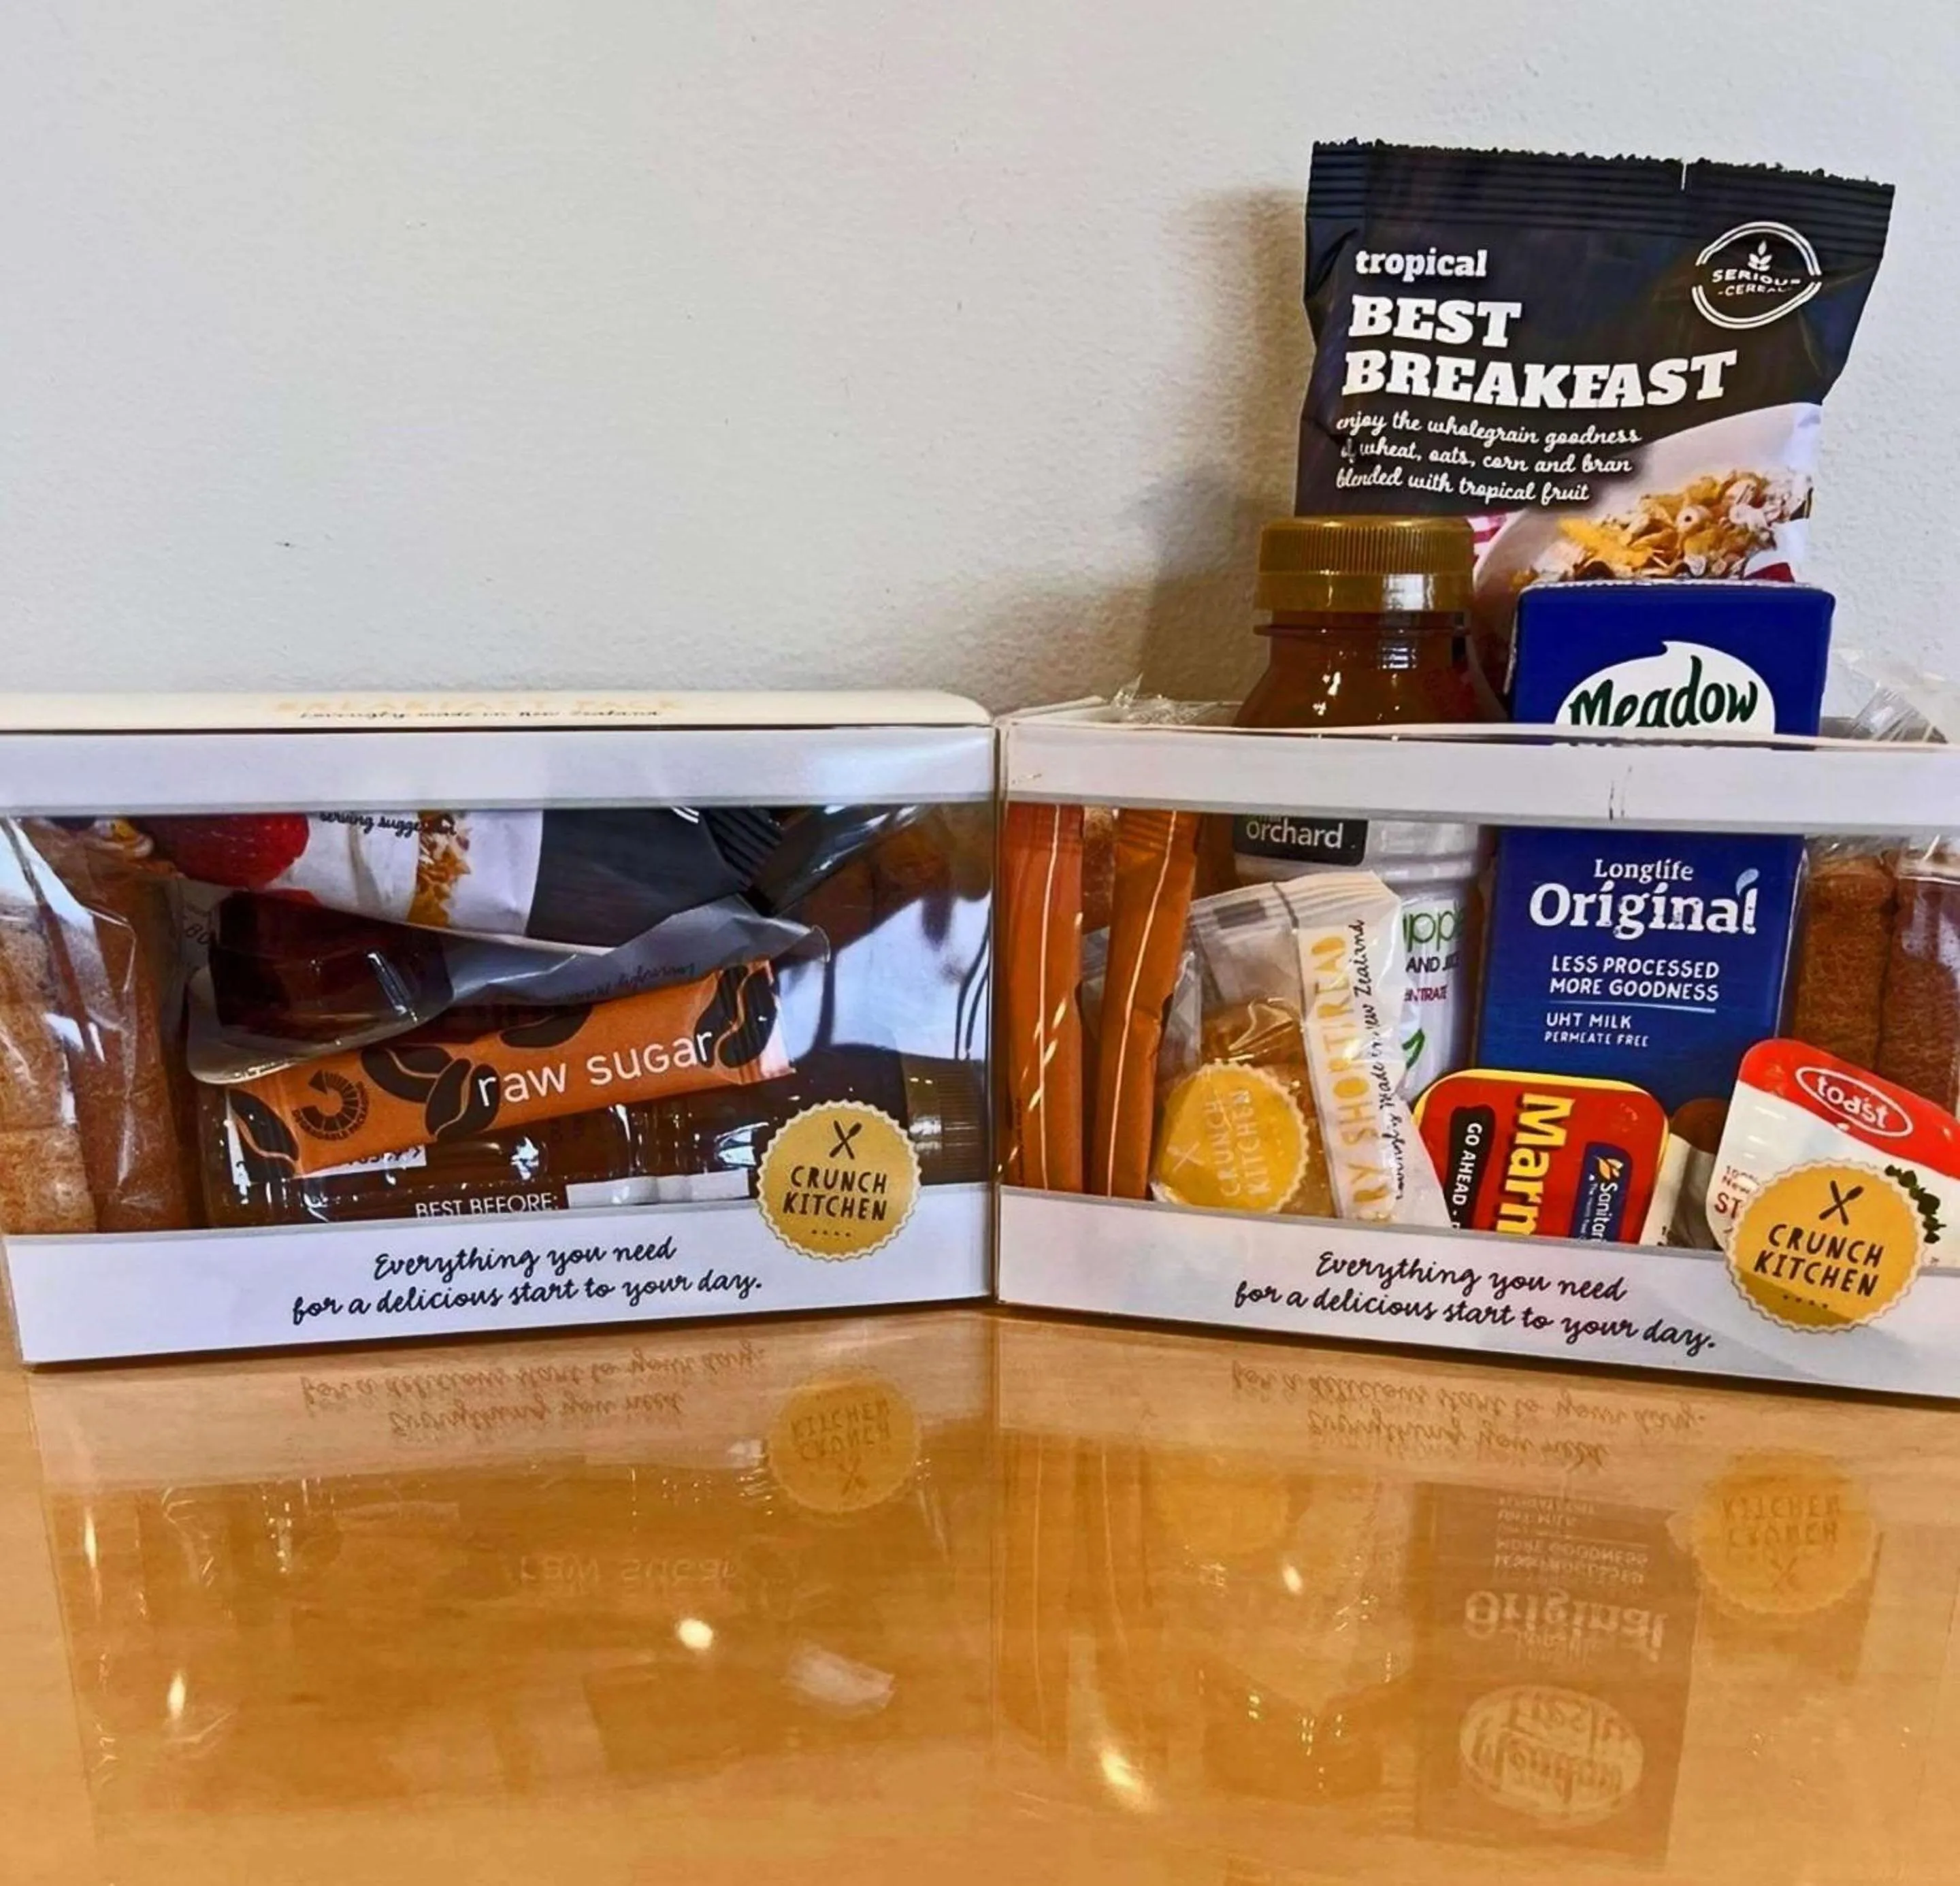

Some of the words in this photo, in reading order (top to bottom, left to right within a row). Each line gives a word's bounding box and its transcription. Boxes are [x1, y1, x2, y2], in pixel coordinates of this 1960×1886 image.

[1356, 250, 1488, 282] tropical
[1350, 295, 1522, 346] BEST
[1342, 350, 1737, 409] BREAKFAST
[1337, 411, 1386, 436] enjoy
[1392, 410, 1422, 431] the
[1427, 415, 1539, 447] wholegrain
[1545, 425, 1642, 453] goodness
[1360, 437, 1422, 460] wheat,
[1428, 446, 1475, 467] oats,
[1483, 455, 1528, 472] corn
[1534, 455, 1576, 472] and
[1582, 453, 1631, 472] bran
[1336, 465, 1402, 488] blended
[1408, 474, 1452, 493] with
[1459, 476, 1535, 504] tropical
[1541, 483, 1590, 504] fruit
[1569, 655, 1759, 728] Meadow
[320, 812, 374, 834] serving
[1592, 858, 1695, 883] Longlife
[1529, 880, 1757, 941] Original
[1405, 956, 1440, 973] AND
[1552, 954, 1597, 974] LESS
[1603, 957, 1719, 979] PROCESSED
[1549, 977, 1601, 996] MORE
[1608, 979, 1720, 1003] GOODNESS
[1544, 1030, 1612, 1045] PERMEATE
[1616, 1033, 1649, 1047] FREE
[1546, 1012, 1583, 1028] UHT
[1588, 1013, 1632, 1030] MILK
[476, 1060, 566, 1107] raw
[1817, 1076, 1888, 1128] toast
[1205, 1098, 1241, 1197] CRUNCH
[1230, 1089, 1273, 1196] KITCHEN
[1465, 1123, 1482, 1145] GO
[790, 1165, 887, 1194] CRUNCH
[1453, 1151, 1476, 1205] AHEAD
[415, 1200, 463, 1218] BEST
[783, 1192, 887, 1220] KITCHEN
[374, 1248, 540, 1284] Everything
[546, 1250, 607, 1275] you
[614, 1237, 678, 1261] need
[1769, 1224, 1883, 1268] CRUNCH
[1315, 1251, 1481, 1295] Everything
[1488, 1273, 1551, 1301] you
[1556, 1275, 1628, 1303] need
[1754, 1250, 1879, 1296] KITCHEN
[293, 1297, 344, 1326] for
[348, 1297, 371, 1315] a
[375, 1280, 503, 1314] delicious
[508, 1278, 578, 1303] start
[584, 1278, 615, 1298] to
[622, 1275, 690, 1307] your
[697, 1270, 763, 1300] day.
[1234, 1280, 1281, 1308] for
[1286, 1291, 1309, 1307] a
[1313, 1287, 1438, 1322] delicious
[1442, 1301, 1516, 1327] start
[1521, 1307, 1554, 1329] to
[1561, 1314, 1638, 1346] your
[1642, 1318, 1717, 1358] day.
